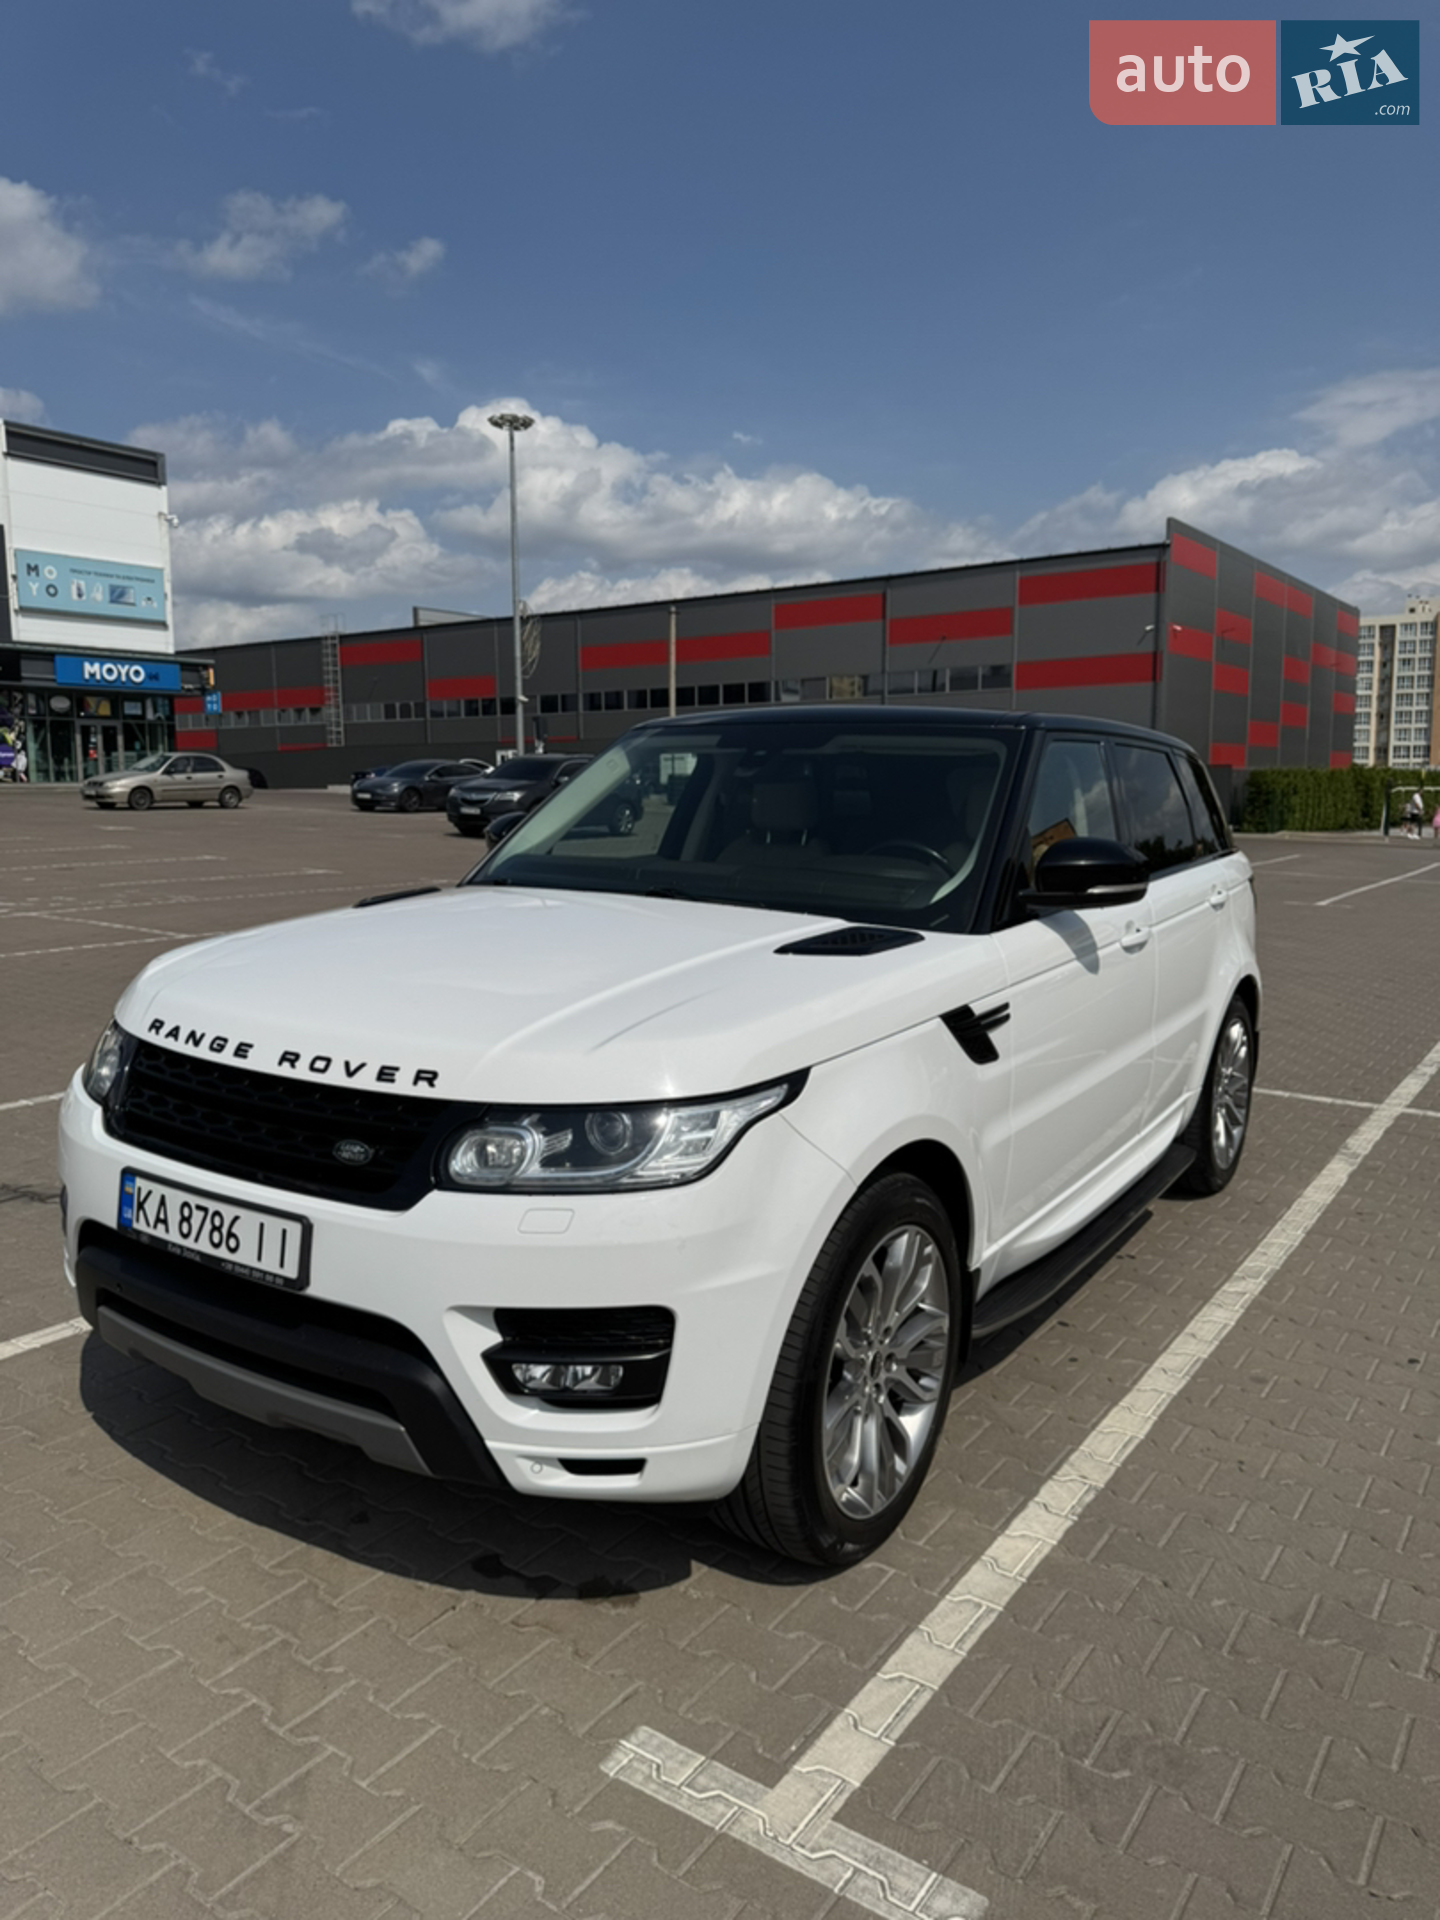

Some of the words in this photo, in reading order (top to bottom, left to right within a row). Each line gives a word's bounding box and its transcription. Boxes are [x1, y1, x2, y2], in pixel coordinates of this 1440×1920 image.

[83, 662, 146, 683] MOYO
[148, 1018, 254, 1060] RANGE
[277, 1050, 440, 1088] ROVER
[135, 1186, 170, 1235] KA
[178, 1201, 242, 1254] 8786
